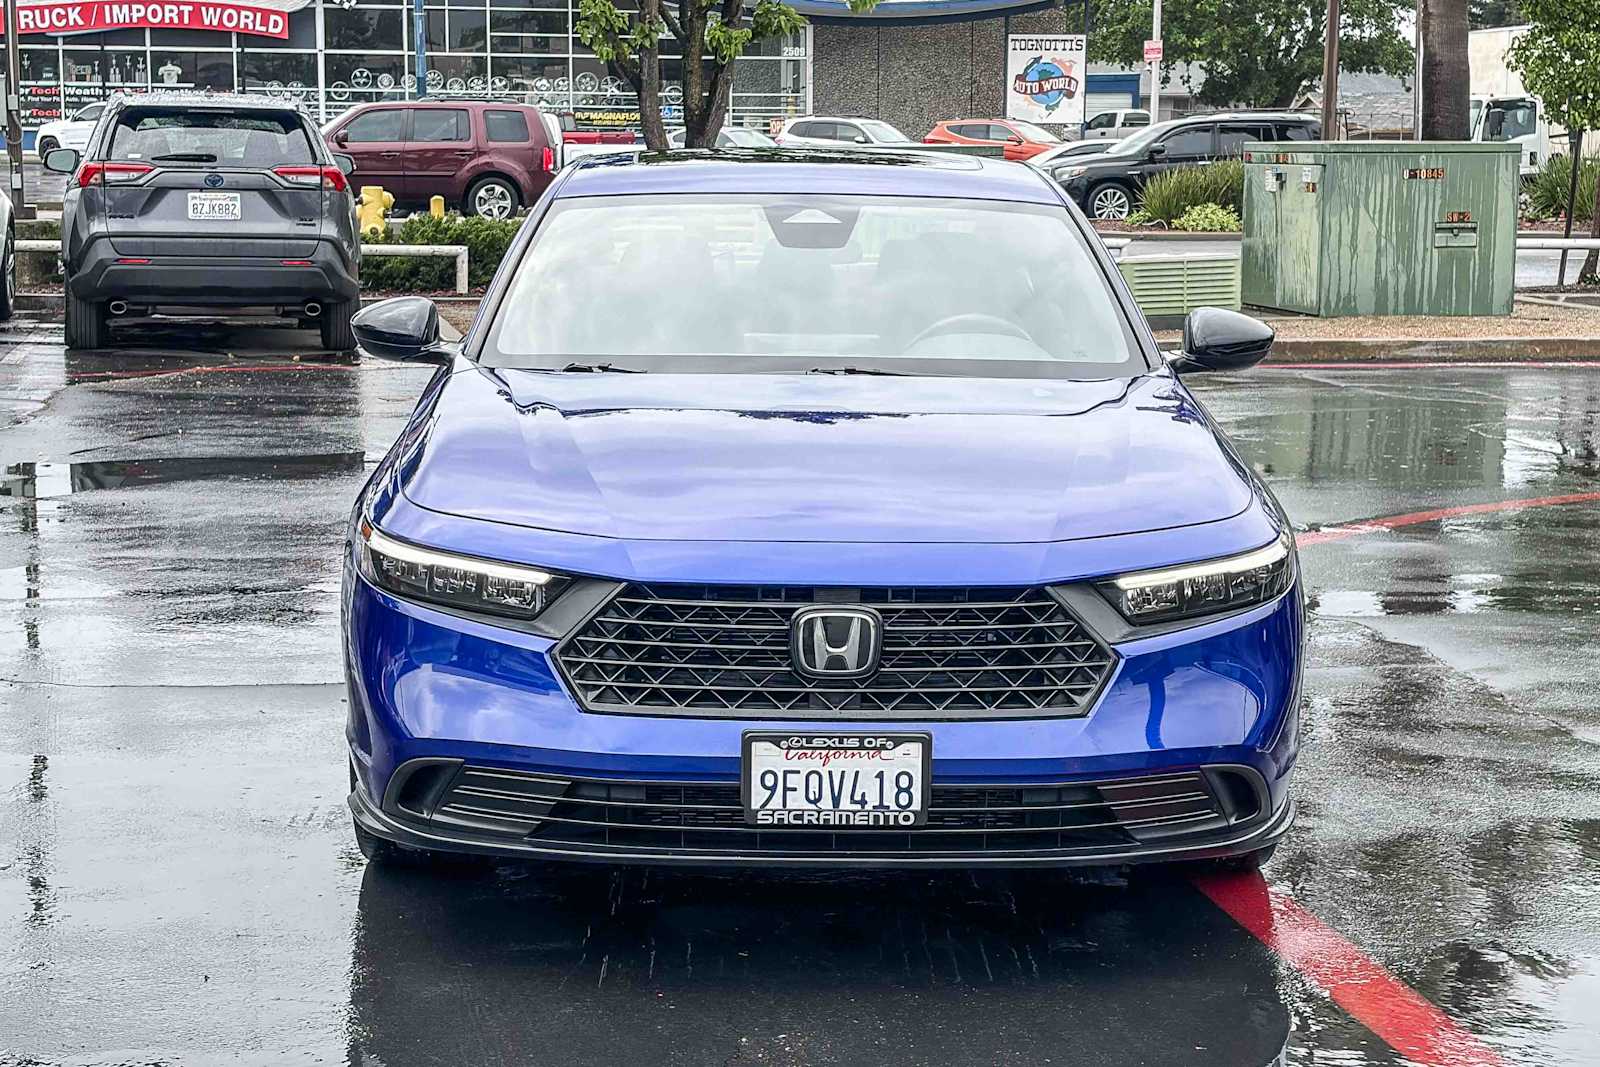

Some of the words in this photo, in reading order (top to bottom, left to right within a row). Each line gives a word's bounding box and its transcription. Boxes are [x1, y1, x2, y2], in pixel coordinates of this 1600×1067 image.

[19, 6, 85, 29] RUCK
[104, 4, 194, 24] IMPORT
[201, 6, 284, 33] WORLD
[783, 46, 806, 56] 2509
[1010, 37, 1084, 51] TOGNOTTI'S
[1014, 81, 1039, 94] AUTO
[1041, 77, 1077, 93] WORLD
[802, 737, 860, 748] LEXUS
[863, 737, 888, 748] OF
[759, 769, 914, 810] 9FQV418
[756, 810, 916, 826] SACRAMENTO
